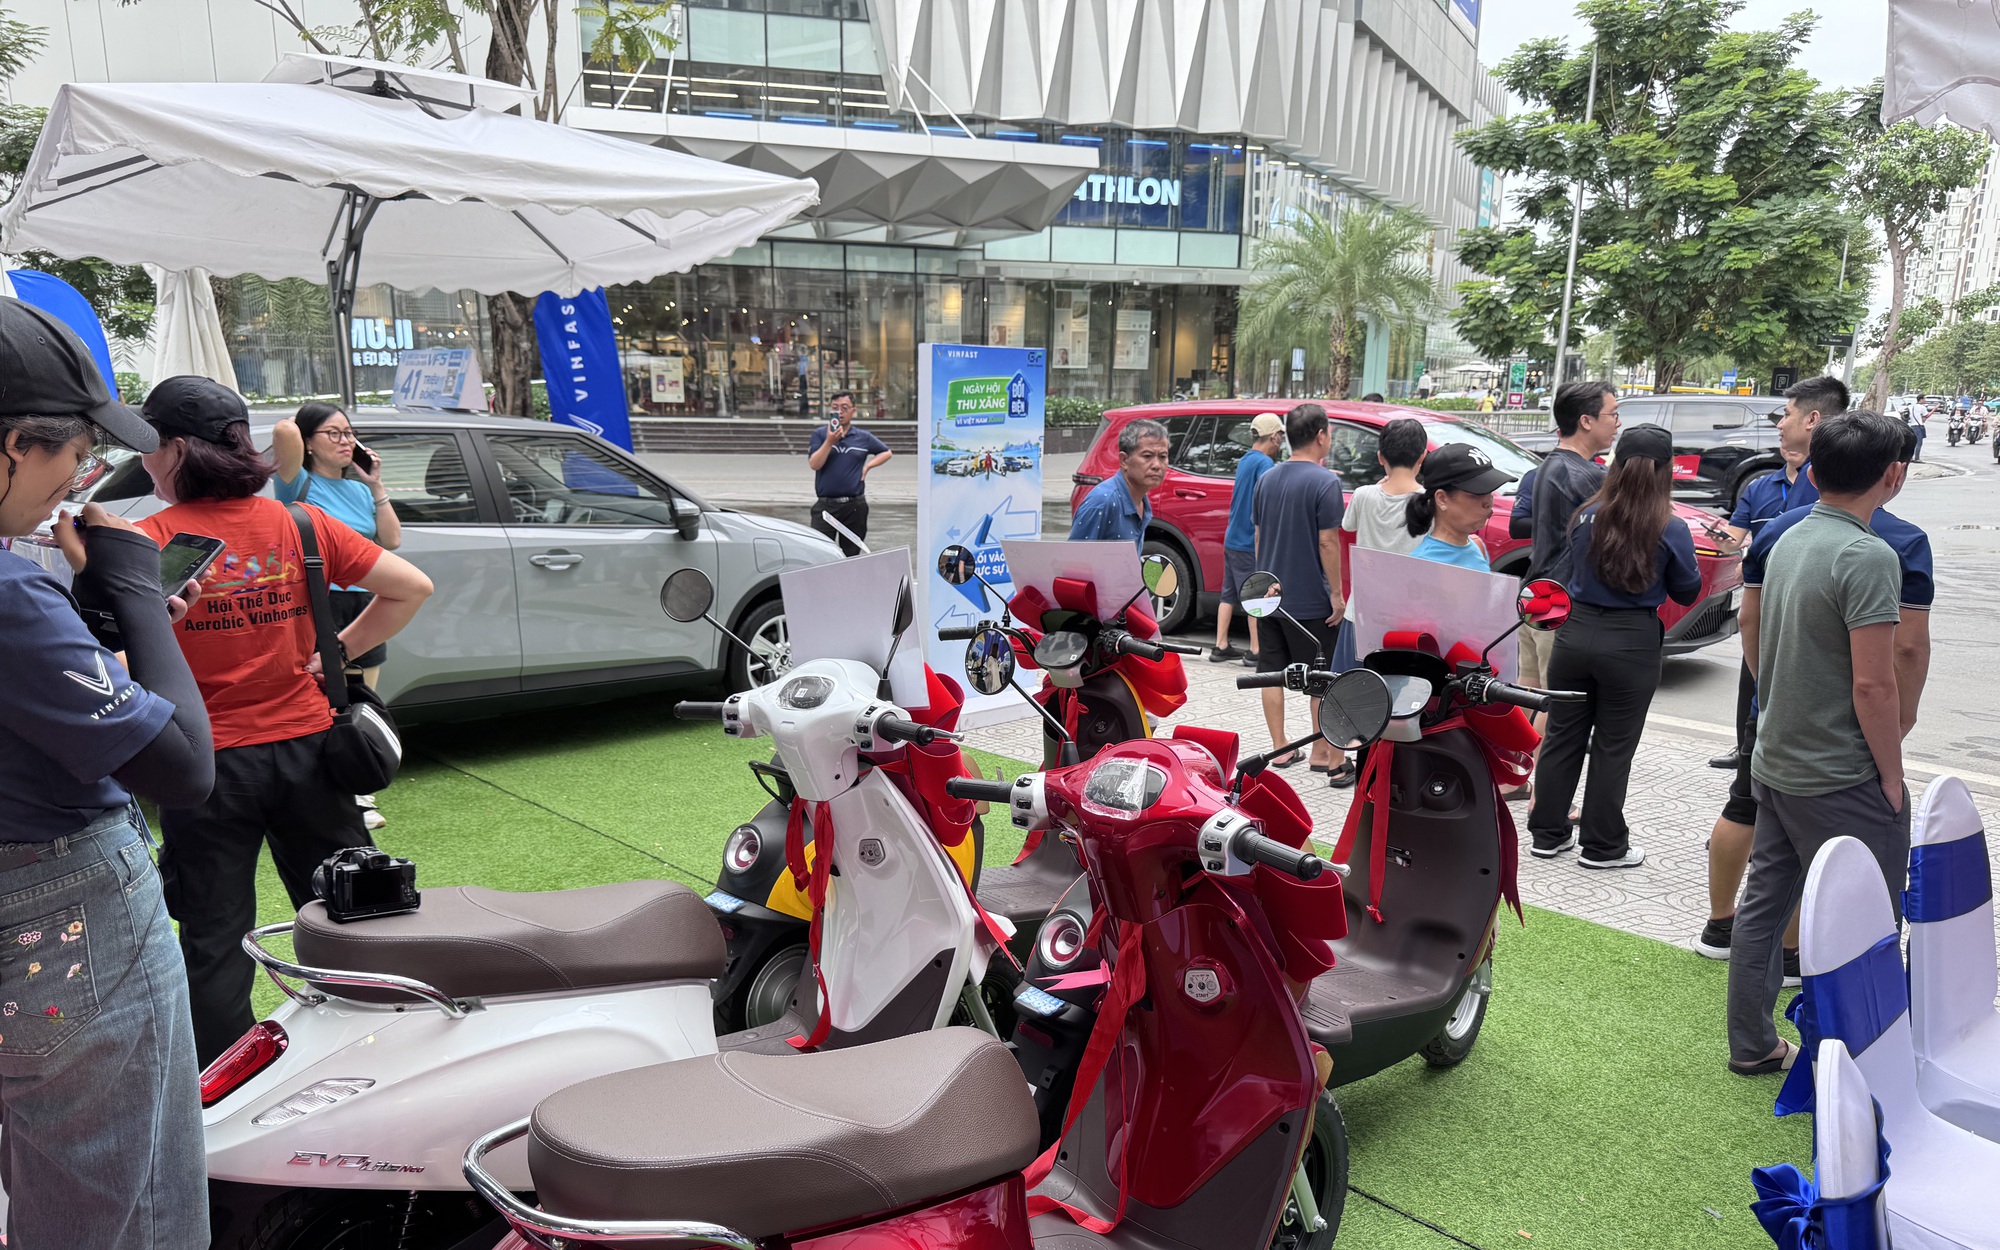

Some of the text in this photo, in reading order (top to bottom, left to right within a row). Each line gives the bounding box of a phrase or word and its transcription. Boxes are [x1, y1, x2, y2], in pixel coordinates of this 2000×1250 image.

[560, 296, 589, 402] VINFAS
[428, 353, 448, 366] VF5
[401, 369, 422, 399] 41
[963, 382, 1000, 395] NGÀY HỘI
[956, 396, 1005, 410] THU XĂNG
[975, 551, 1005, 564] ỐI VÀO
[992, 563, 1006, 576] SỰ
[207, 599, 233, 616] Hội
[267, 591, 292, 607] Dục
[184, 604, 308, 632] Aerobic Vinhomes
[91, 684, 136, 720] VINFAST
